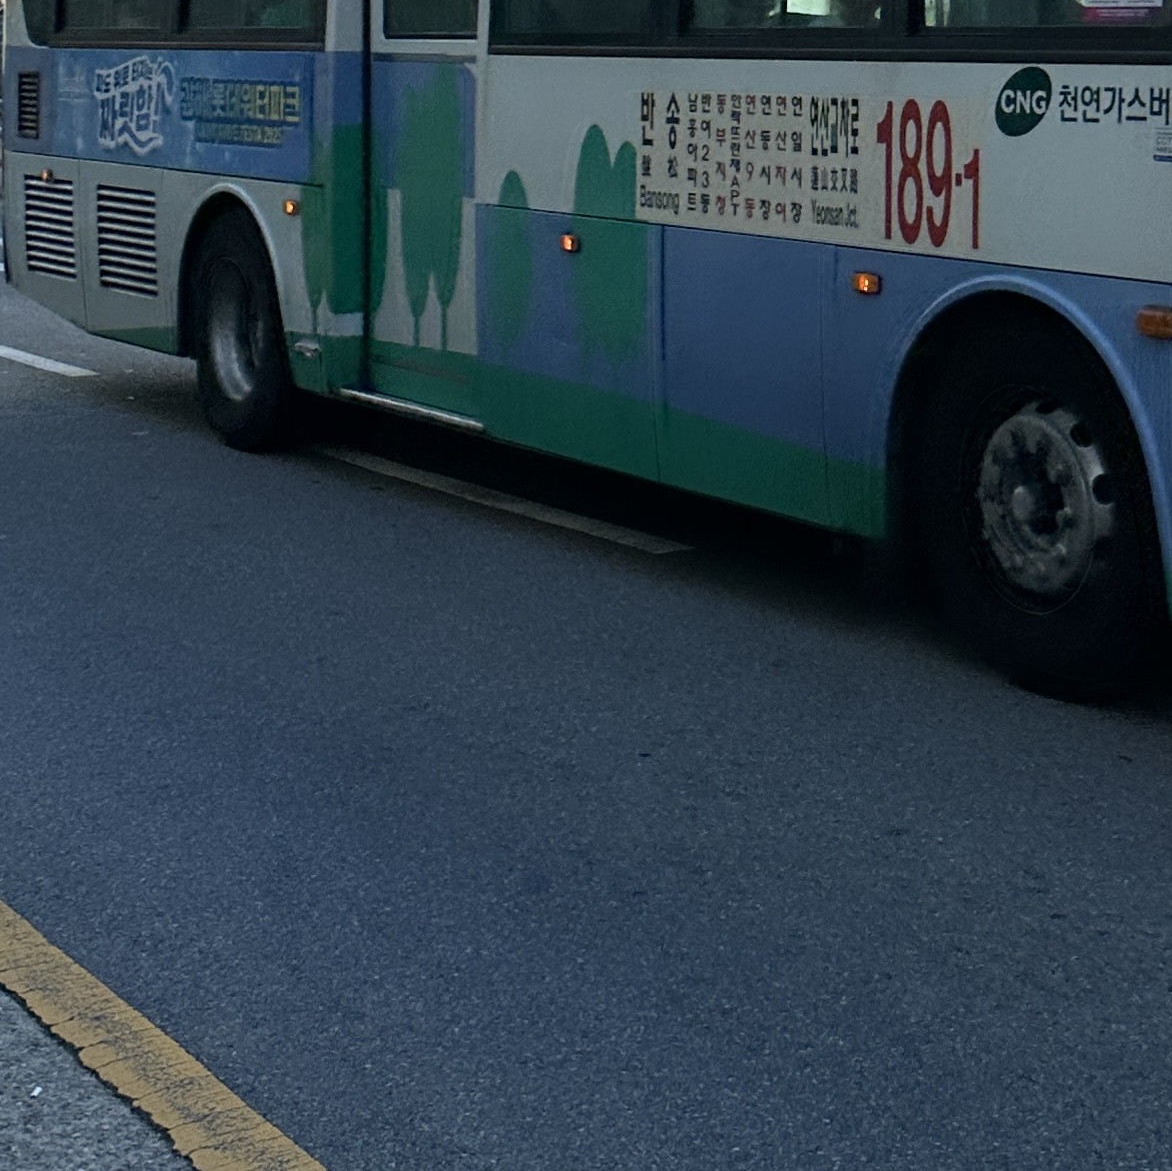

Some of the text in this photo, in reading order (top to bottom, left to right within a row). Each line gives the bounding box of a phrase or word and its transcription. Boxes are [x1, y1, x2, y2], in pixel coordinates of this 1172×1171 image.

[641, 92, 680, 149] 반송
[810, 95, 859, 158] 연산교차로
[1000, 89, 1048, 115] CNG
[640, 184, 680, 215] Bansong
[876, 99, 980, 249] 189-1
